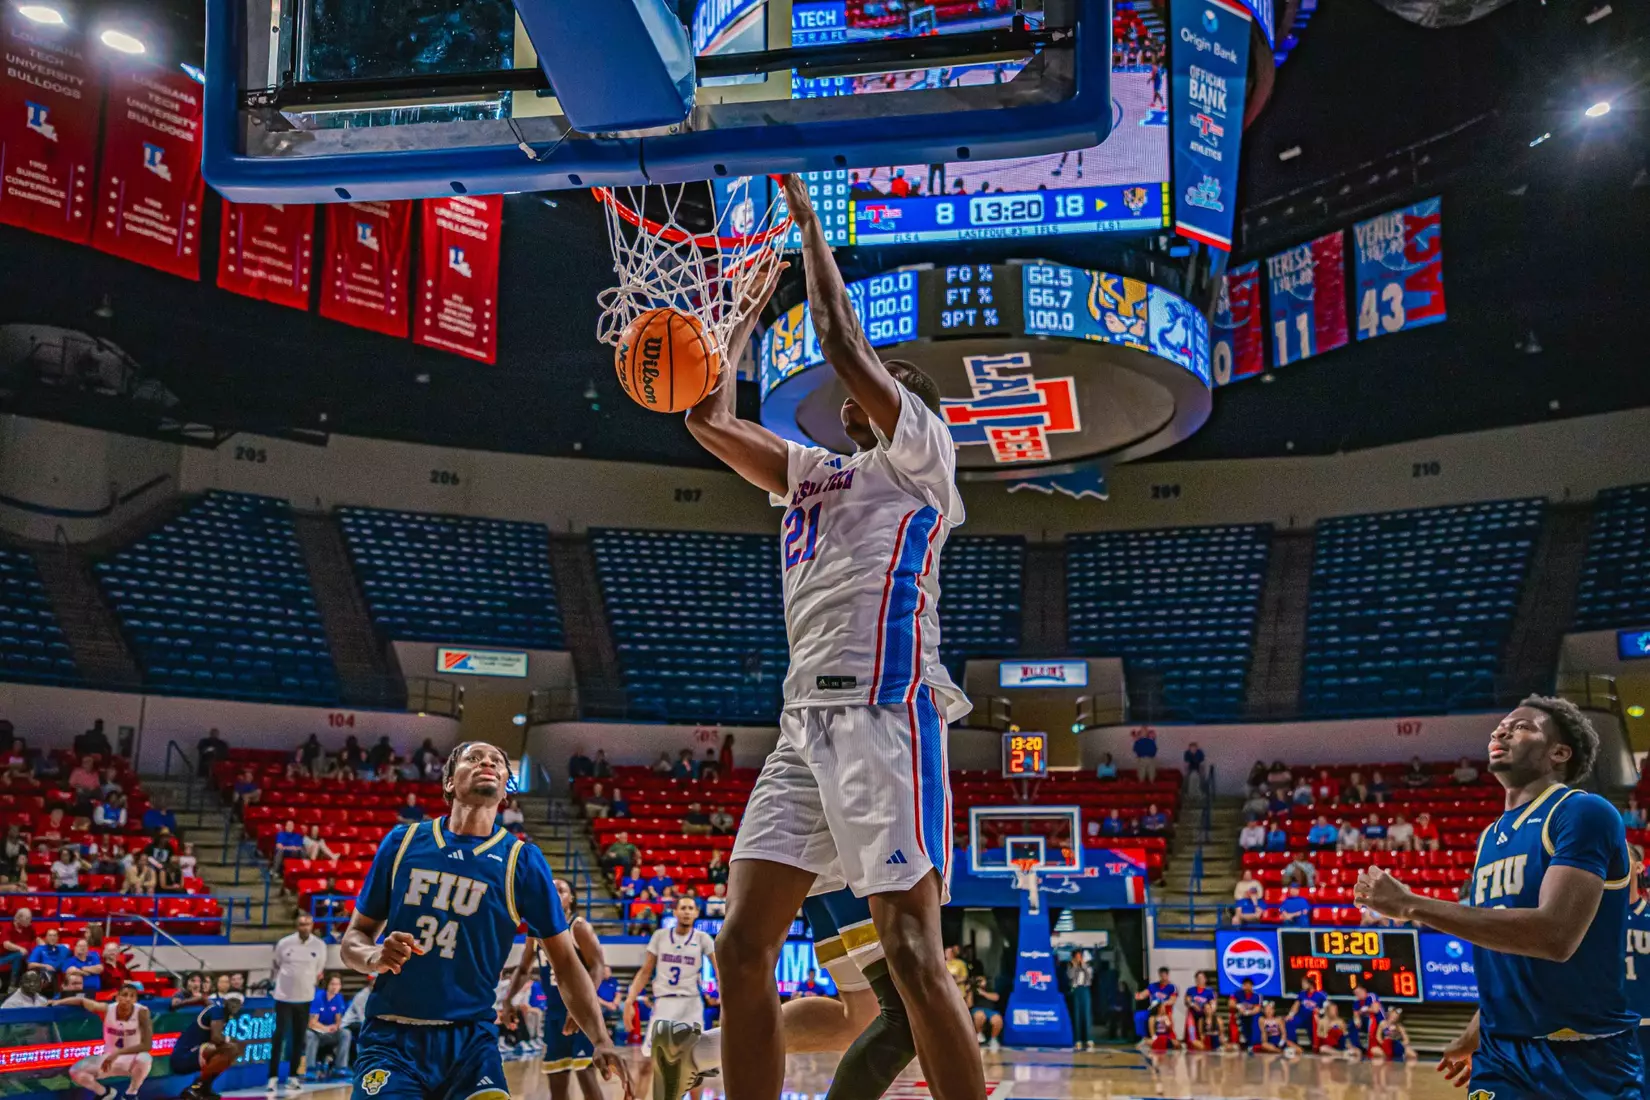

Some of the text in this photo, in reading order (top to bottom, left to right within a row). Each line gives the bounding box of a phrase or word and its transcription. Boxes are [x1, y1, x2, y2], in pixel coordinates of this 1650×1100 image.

[799, 10, 836, 27] TECH
[29, 47, 64, 67] TECH
[1181, 27, 1237, 64] Origin Bank
[6, 53, 84, 86] UNIVERSITY
[1190, 64, 1227, 92] OFFICIAL
[7, 67, 81, 99] BULLDOGS
[1189, 78, 1227, 112] BANK
[127, 96, 198, 129] UNIVERSITY
[127, 110, 194, 141] BULLDOGS
[936, 195, 1084, 225] 8 13:20 18
[1356, 212, 1404, 248] VENUS
[946, 264, 993, 283] FG %
[1268, 247, 1313, 279] TERESA
[869, 273, 912, 297] 60.0
[1028, 266, 1073, 286] 62.5
[869, 295, 912, 317] 100.0
[946, 287, 992, 306] FT %
[1028, 288, 1073, 309] 66.7
[942, 309, 999, 328] 3PT %
[1028, 310, 1074, 331] 100.0
[1360, 282, 1404, 337] 43
[869, 317, 912, 340] 50.0
[1275, 313, 1310, 366] 11
[642, 336, 662, 404] Wilson
[235, 446, 267, 463] 205
[430, 469, 460, 486] 206
[1412, 462, 1441, 477] 210
[674, 487, 701, 502] 207
[1151, 485, 1181, 500] 209
[784, 501, 822, 572] 21
[328, 712, 355, 728] 104
[1397, 721, 1421, 736] 107
[1011, 737, 1043, 751] 13:20
[1010, 750, 1041, 773] 21
[1475, 854, 1528, 906] FIU
[404, 868, 488, 917] FIU
[414, 915, 460, 959] 34
[1323, 931, 1379, 955] 13:20
[1227, 957, 1272, 970] PEPSI
[1426, 961, 1475, 975] Origin Ba
[669, 966, 681, 986] 3
[1393, 971, 1417, 996] 18
[10, 1048, 62, 1064] FURNITURE
[63, 1046, 91, 1058] STORE
